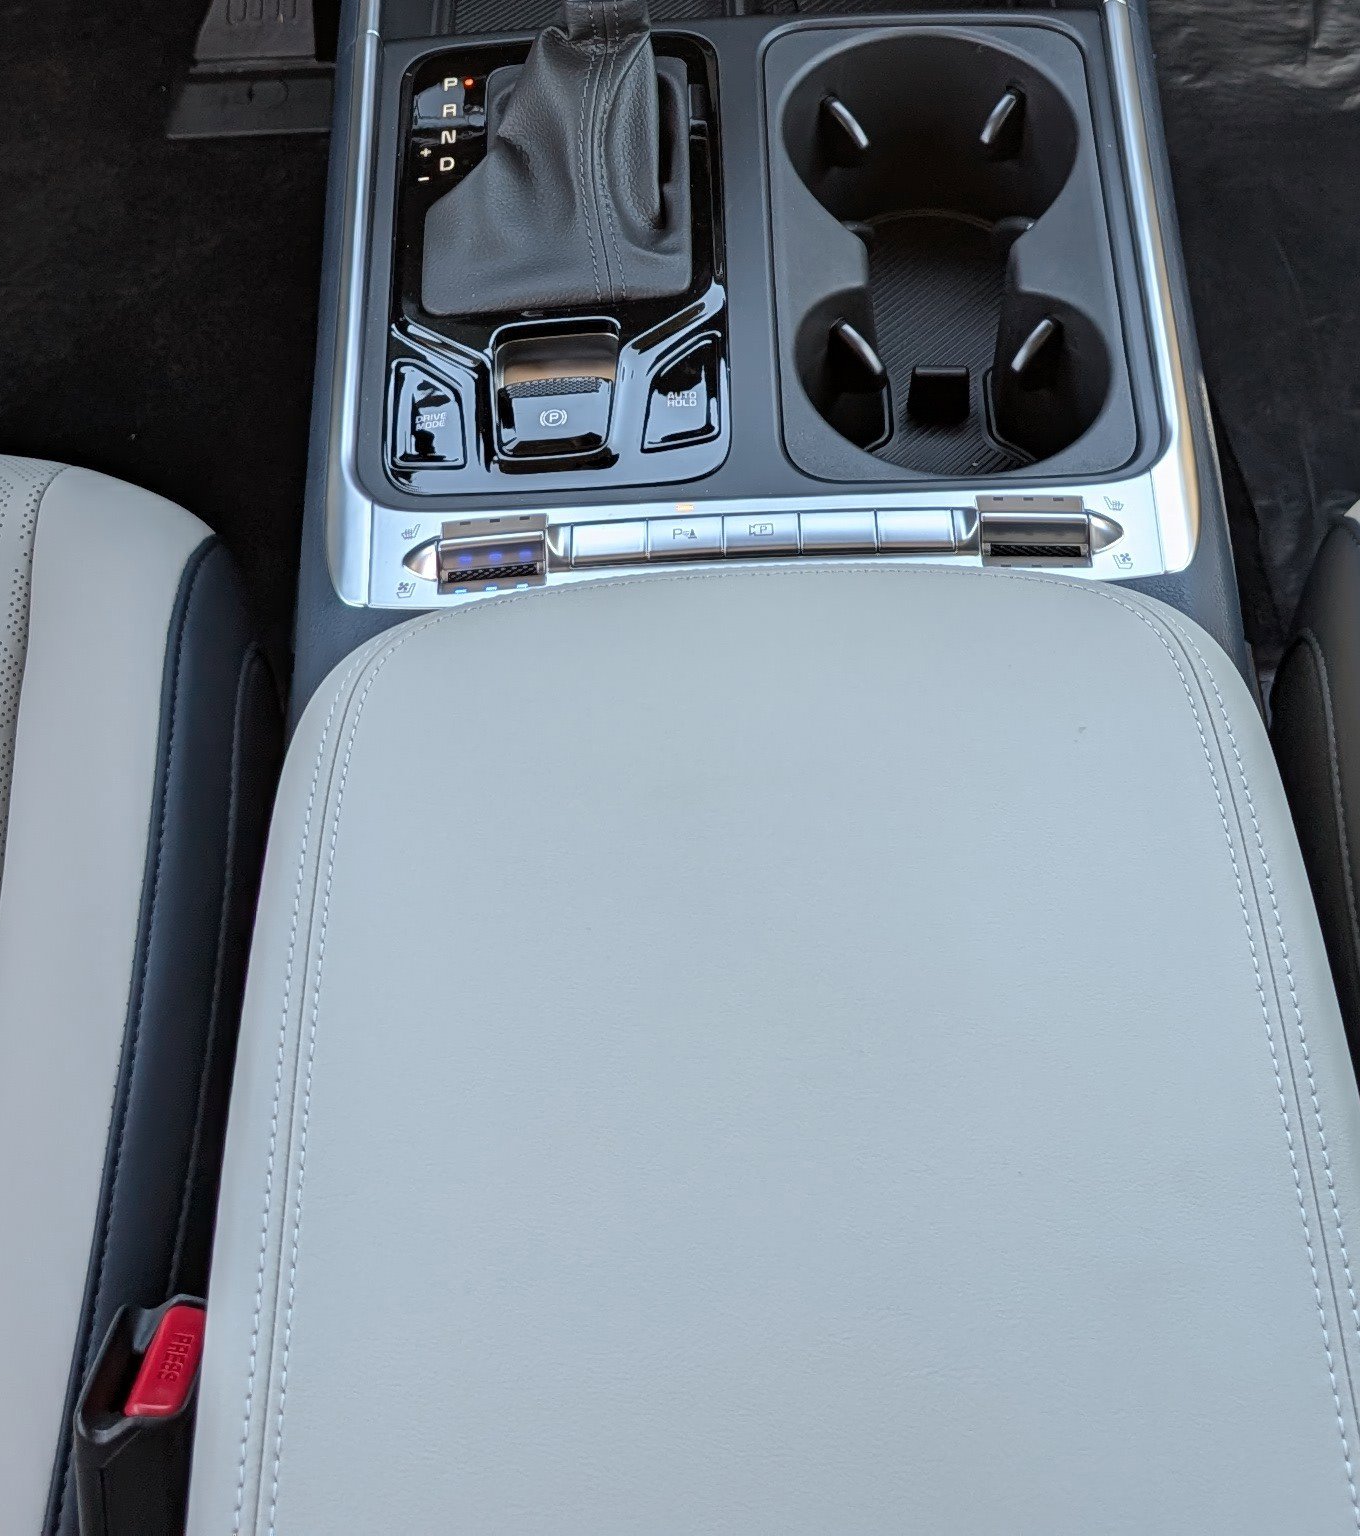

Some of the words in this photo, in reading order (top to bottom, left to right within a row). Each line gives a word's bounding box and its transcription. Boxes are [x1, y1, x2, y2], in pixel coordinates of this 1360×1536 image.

[444, 77, 458, 92] P
[442, 103, 457, 118] R
[441, 129, 457, 145] N
[439, 156, 455, 172] D
[667, 391, 697, 399] AUTO
[667, 398, 697, 407] HOLD
[415, 412, 447, 424] DRIVE
[415, 419, 446, 431] MODE
[159, 1332, 195, 1383] PRESS
